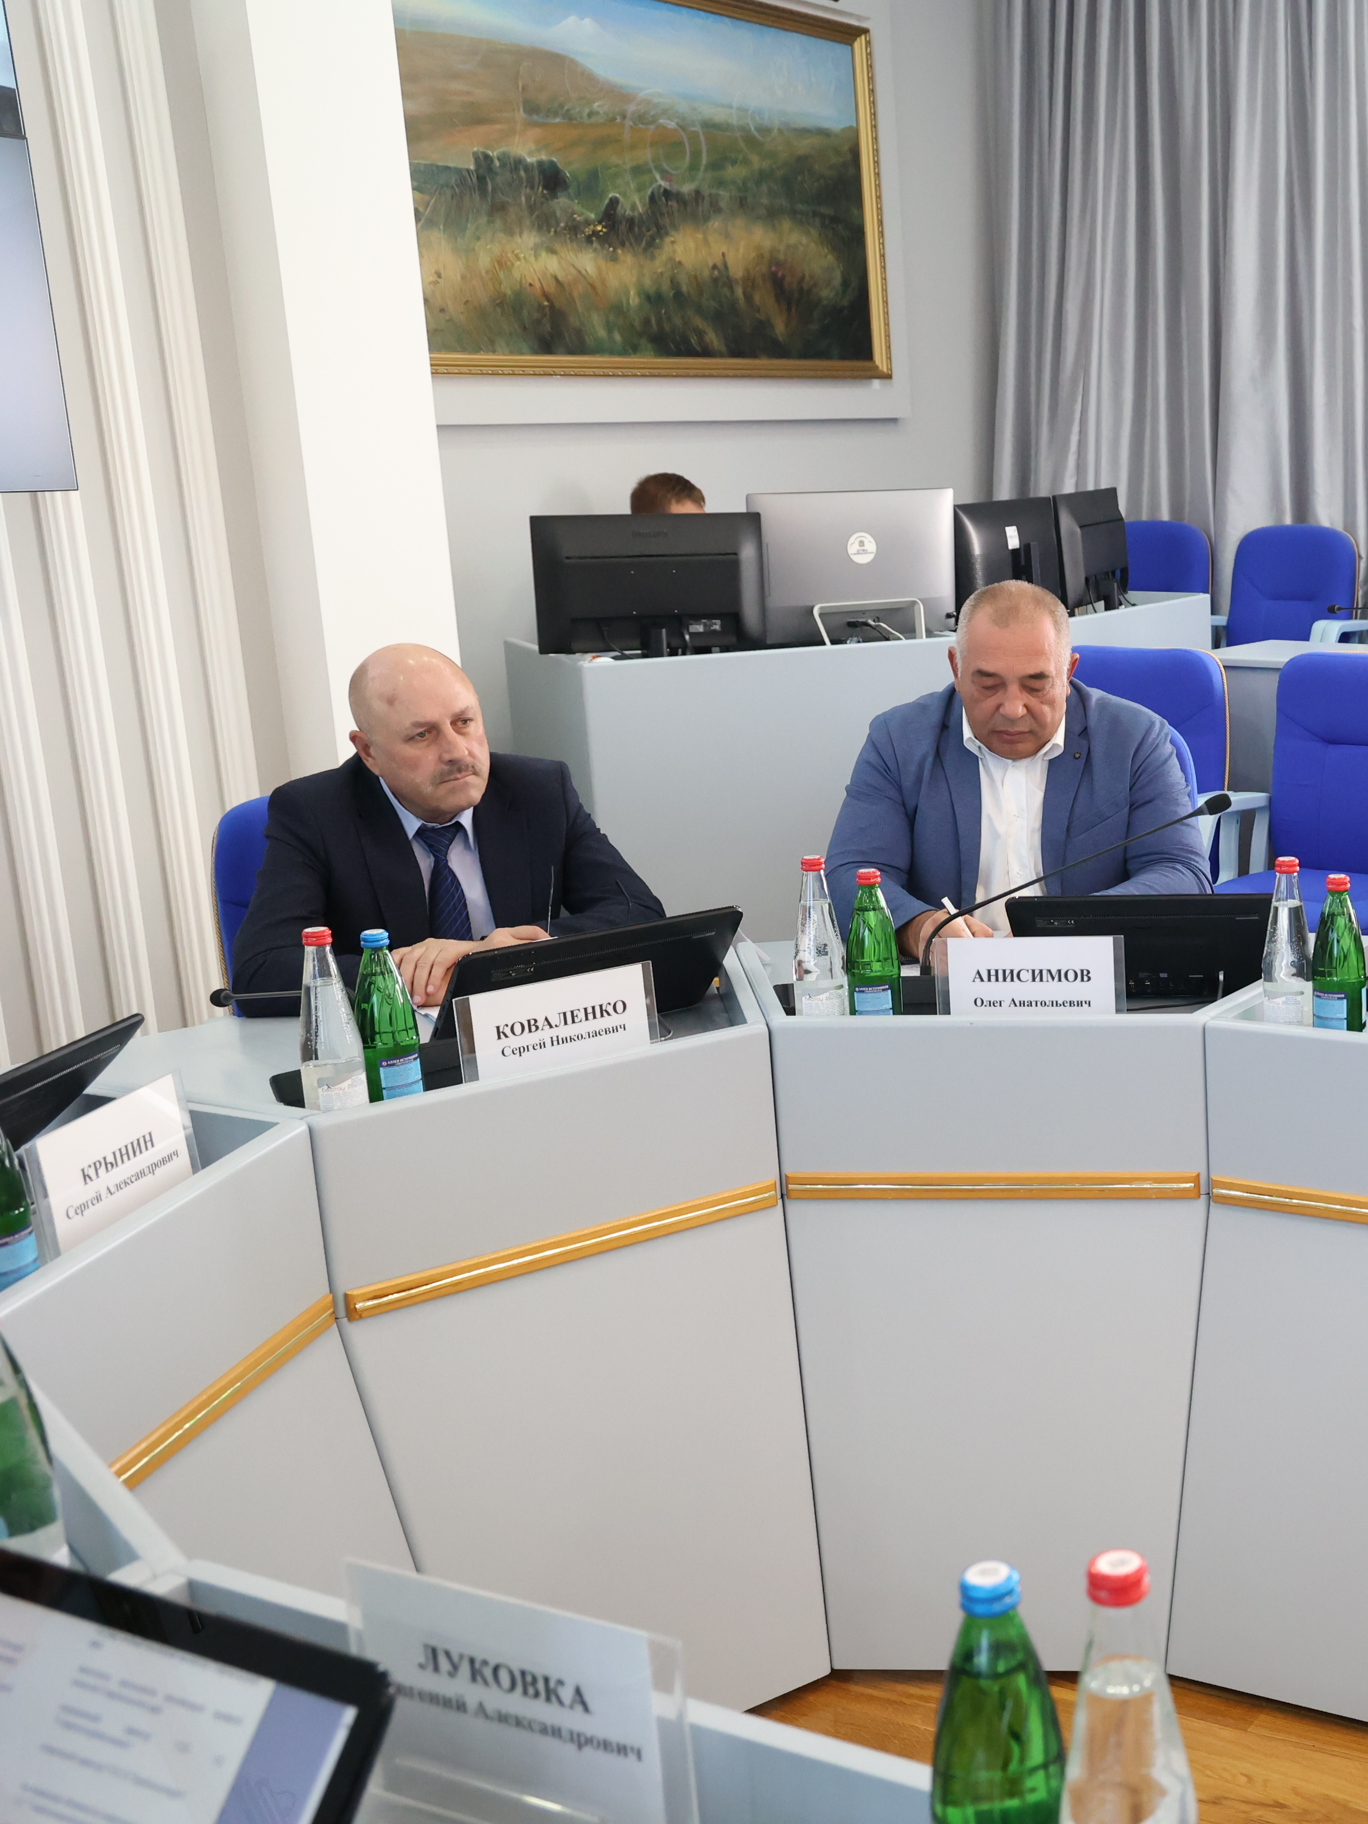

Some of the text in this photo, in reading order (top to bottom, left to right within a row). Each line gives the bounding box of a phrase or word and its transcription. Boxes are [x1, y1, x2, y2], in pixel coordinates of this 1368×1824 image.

[972, 968, 1092, 983] АНИСИМОВ
[494, 999, 628, 1041] КОВАЛЕНКО
[973, 997, 1092, 1008] Олег Анатольевич
[501, 1023, 627, 1058] Сергей Николаевич
[80, 1130, 156, 1186] КРЫНИН
[65, 1149, 180, 1220] Сергей Александрович
[417, 1642, 592, 1715] ЛУКОВКА
[391, 1681, 644, 1763] вгений Александрович
